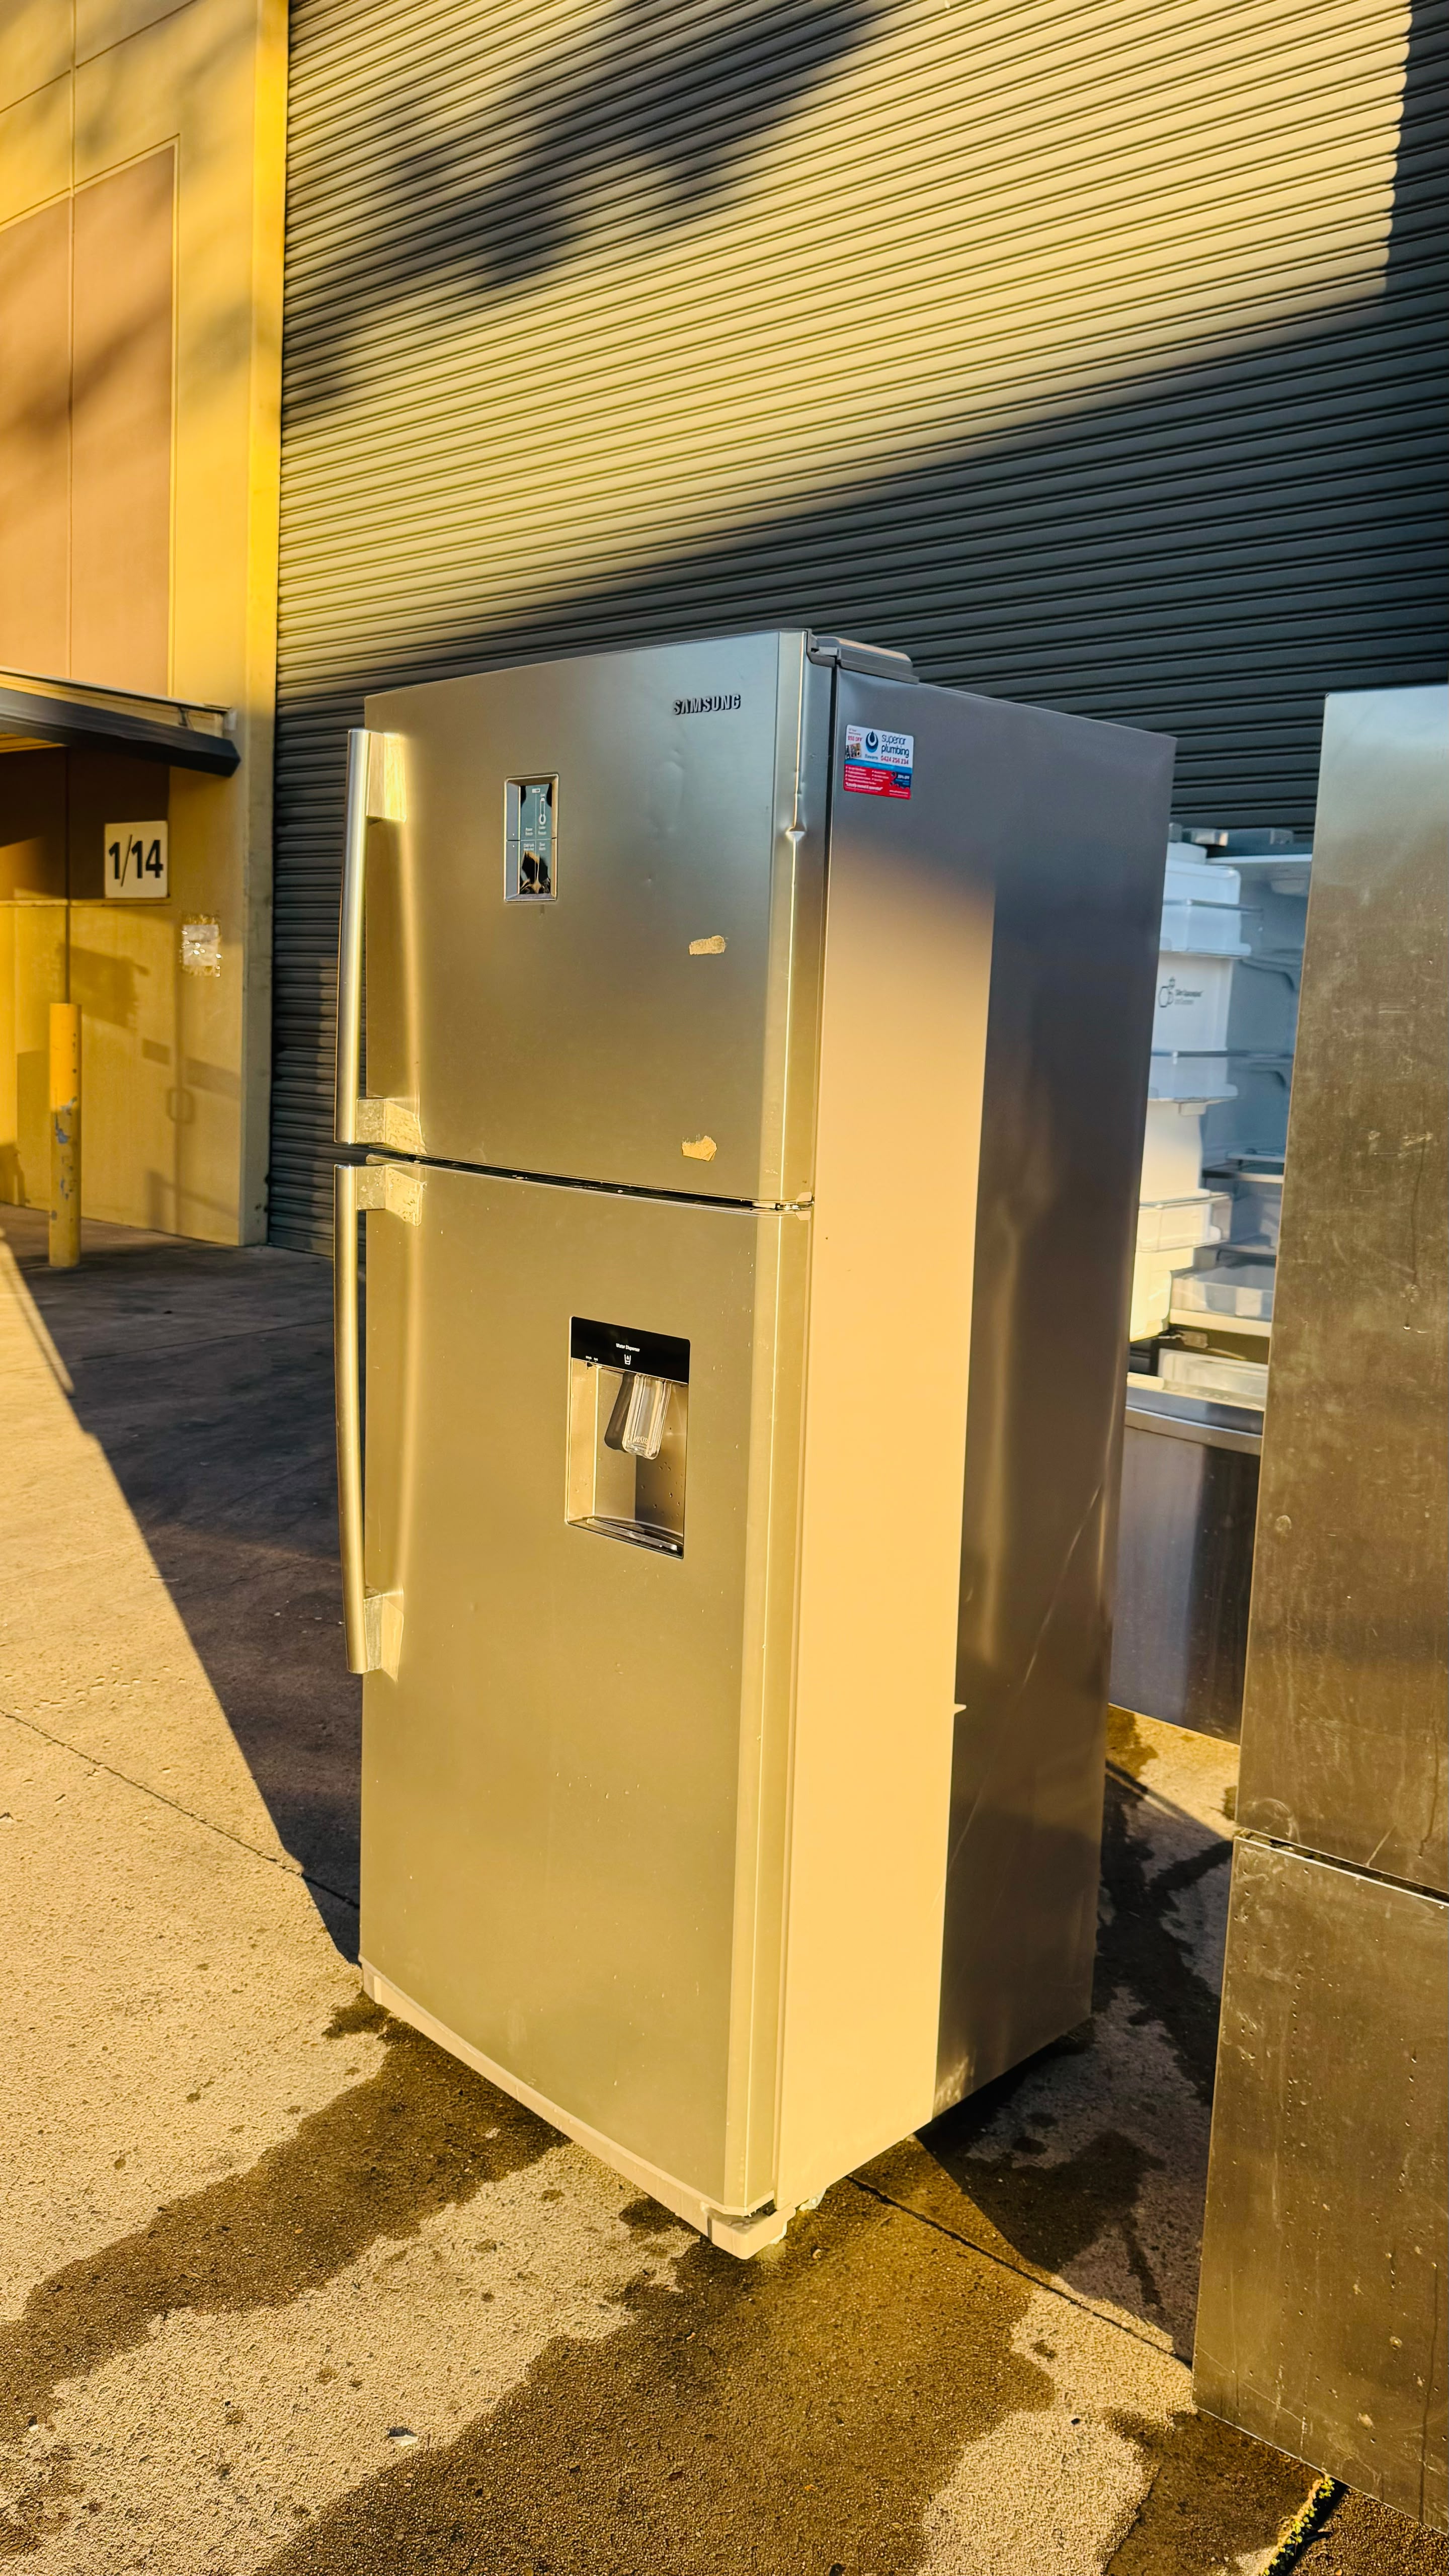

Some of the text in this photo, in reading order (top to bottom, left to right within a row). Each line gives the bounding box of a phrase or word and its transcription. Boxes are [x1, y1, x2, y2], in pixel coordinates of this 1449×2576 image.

[674, 694, 741, 715] SAMSUNG
[882, 735, 906, 745] superior
[881, 745, 909, 758] plumbing
[109, 834, 164, 887] 1/14
